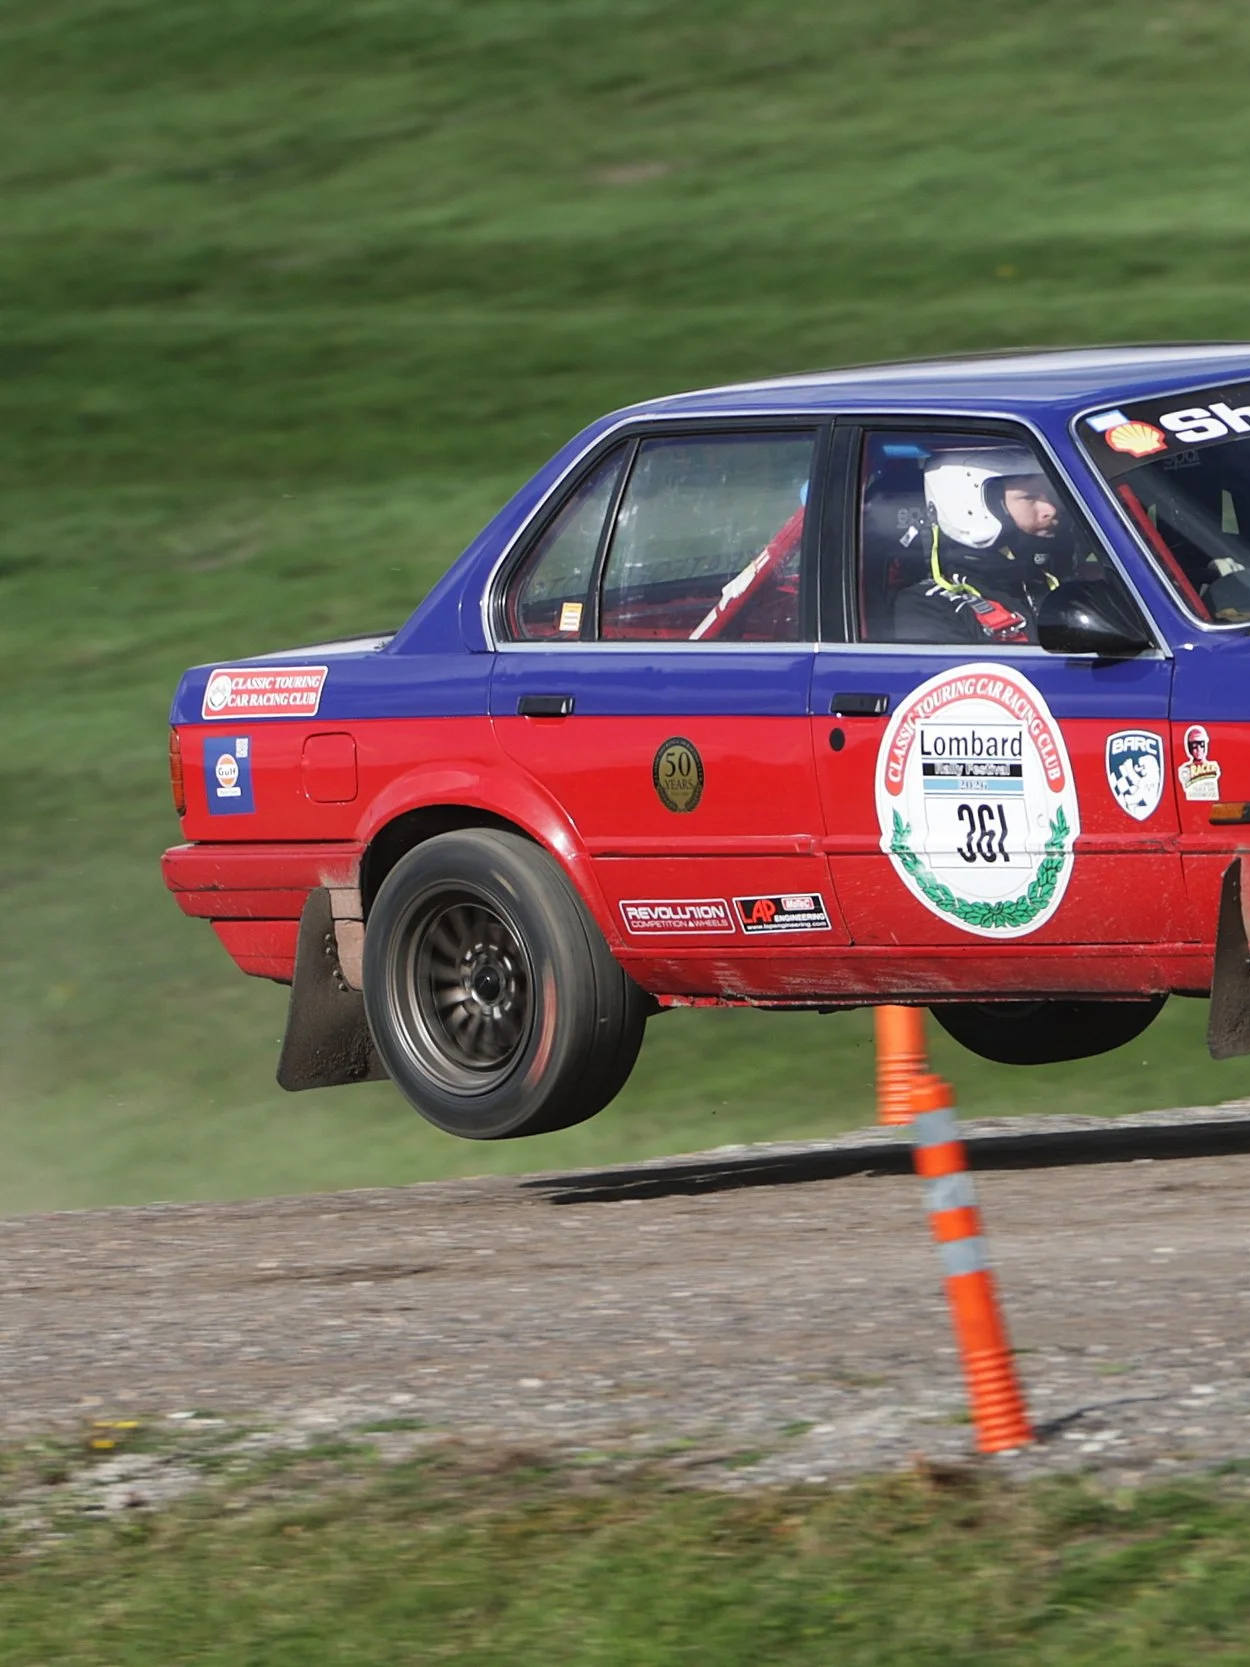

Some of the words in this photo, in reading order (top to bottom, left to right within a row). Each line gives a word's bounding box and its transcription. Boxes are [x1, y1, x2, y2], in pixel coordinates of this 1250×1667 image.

[232, 677, 274, 690] CLASSIC
[275, 675, 321, 688] TOURING
[227, 694, 250, 707] CAR
[250, 692, 290, 705] RACING
[289, 692, 317, 705] CLUB
[887, 712, 917, 783] CLASSIC
[914, 678, 977, 719] TOURING
[976, 677, 1004, 699] CAR
[1001, 686, 1044, 736] RACING
[1037, 732, 1062, 781] CLUB
[920, 730, 1022, 757] Lombard
[1111, 736, 1158, 755] BARC
[218, 766, 237, 777] Gulf
[664, 751, 691, 778] 50
[664, 779, 693, 790] YEARS
[956, 803, 1011, 863] 361
[625, 905, 725, 920] REVOLUTION
[737, 899, 776, 924] LAP
[773, 913, 826, 923] ENGINEERING
[631, 920, 687, 929] COMPETITION
[694, 919, 730, 928] WHEELS
